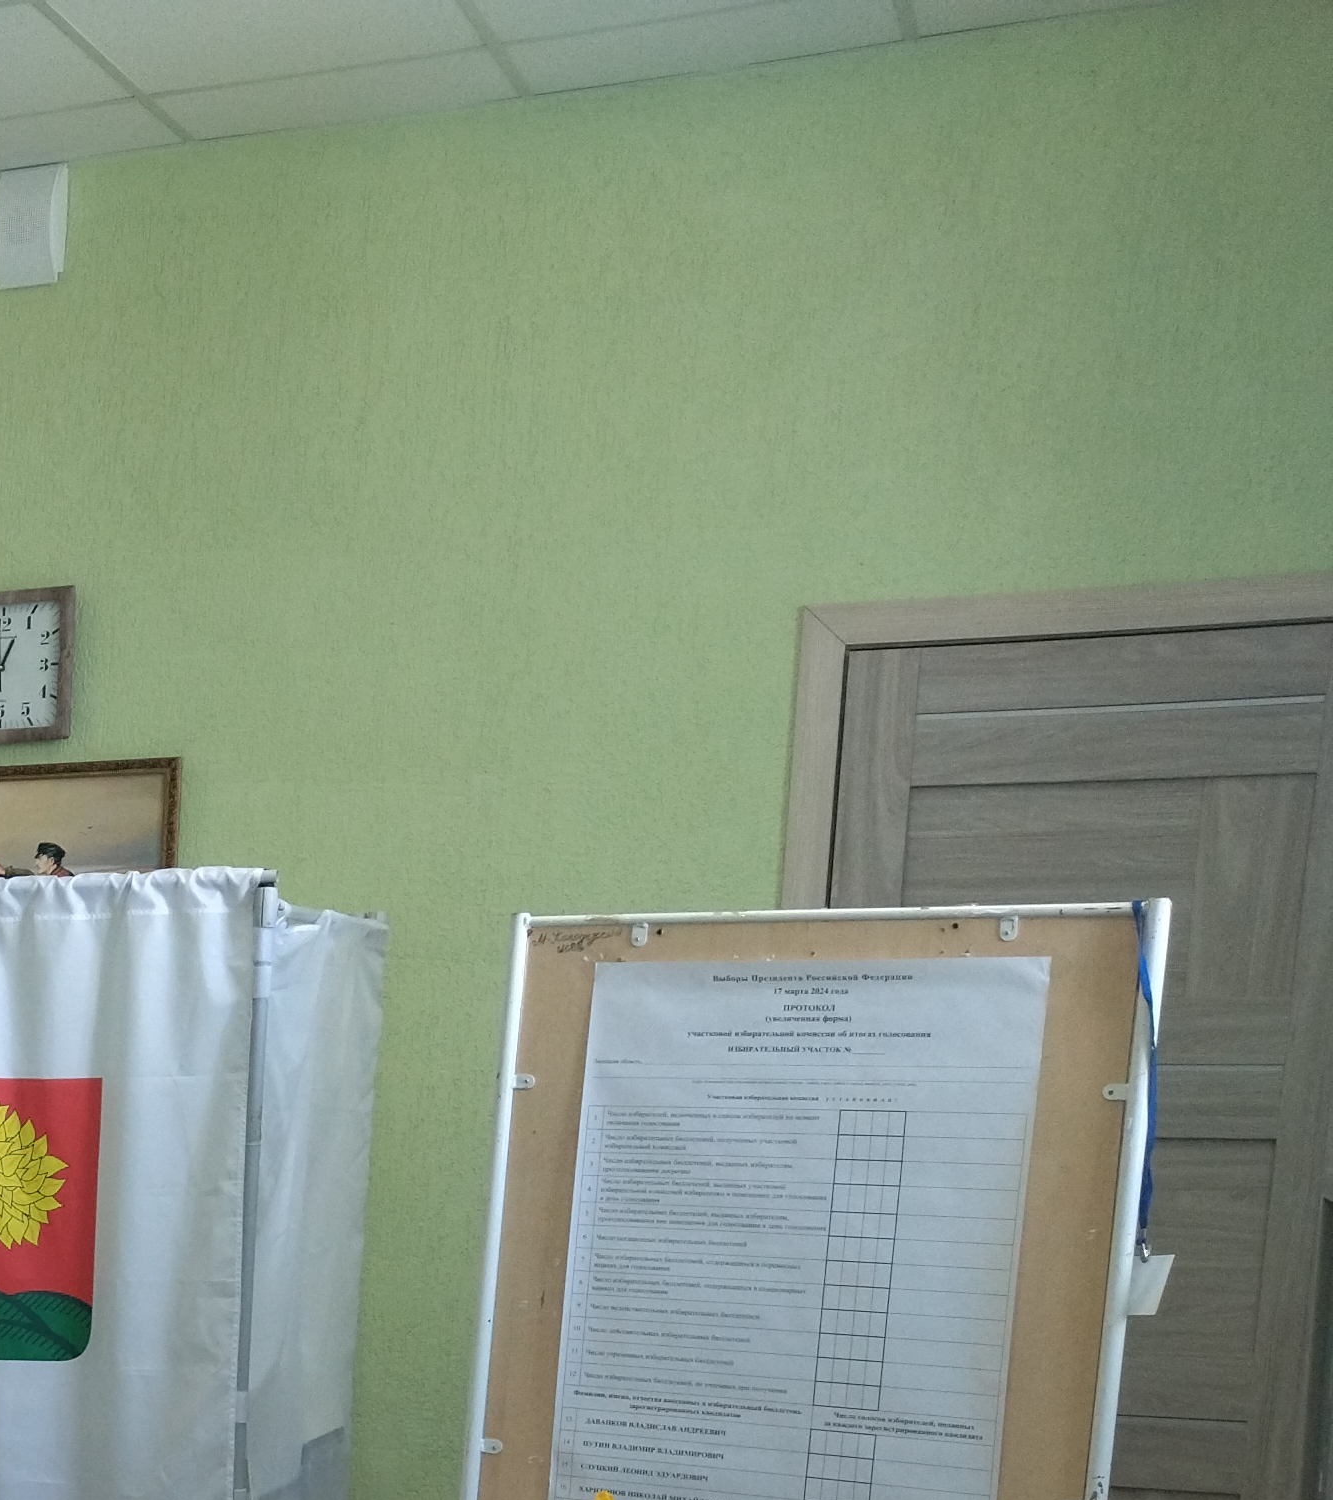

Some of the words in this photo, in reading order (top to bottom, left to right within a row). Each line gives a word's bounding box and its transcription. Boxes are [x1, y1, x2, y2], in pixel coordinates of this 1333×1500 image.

[27, 616, 31, 629] 1
[40, 631, 50, 645] 2
[40, 658, 48, 671] 3
[39, 685, 46, 698] 4
[21, 702, 30, 716] 5
[578, 1485, 625, 1496] ХАРИНОВ
